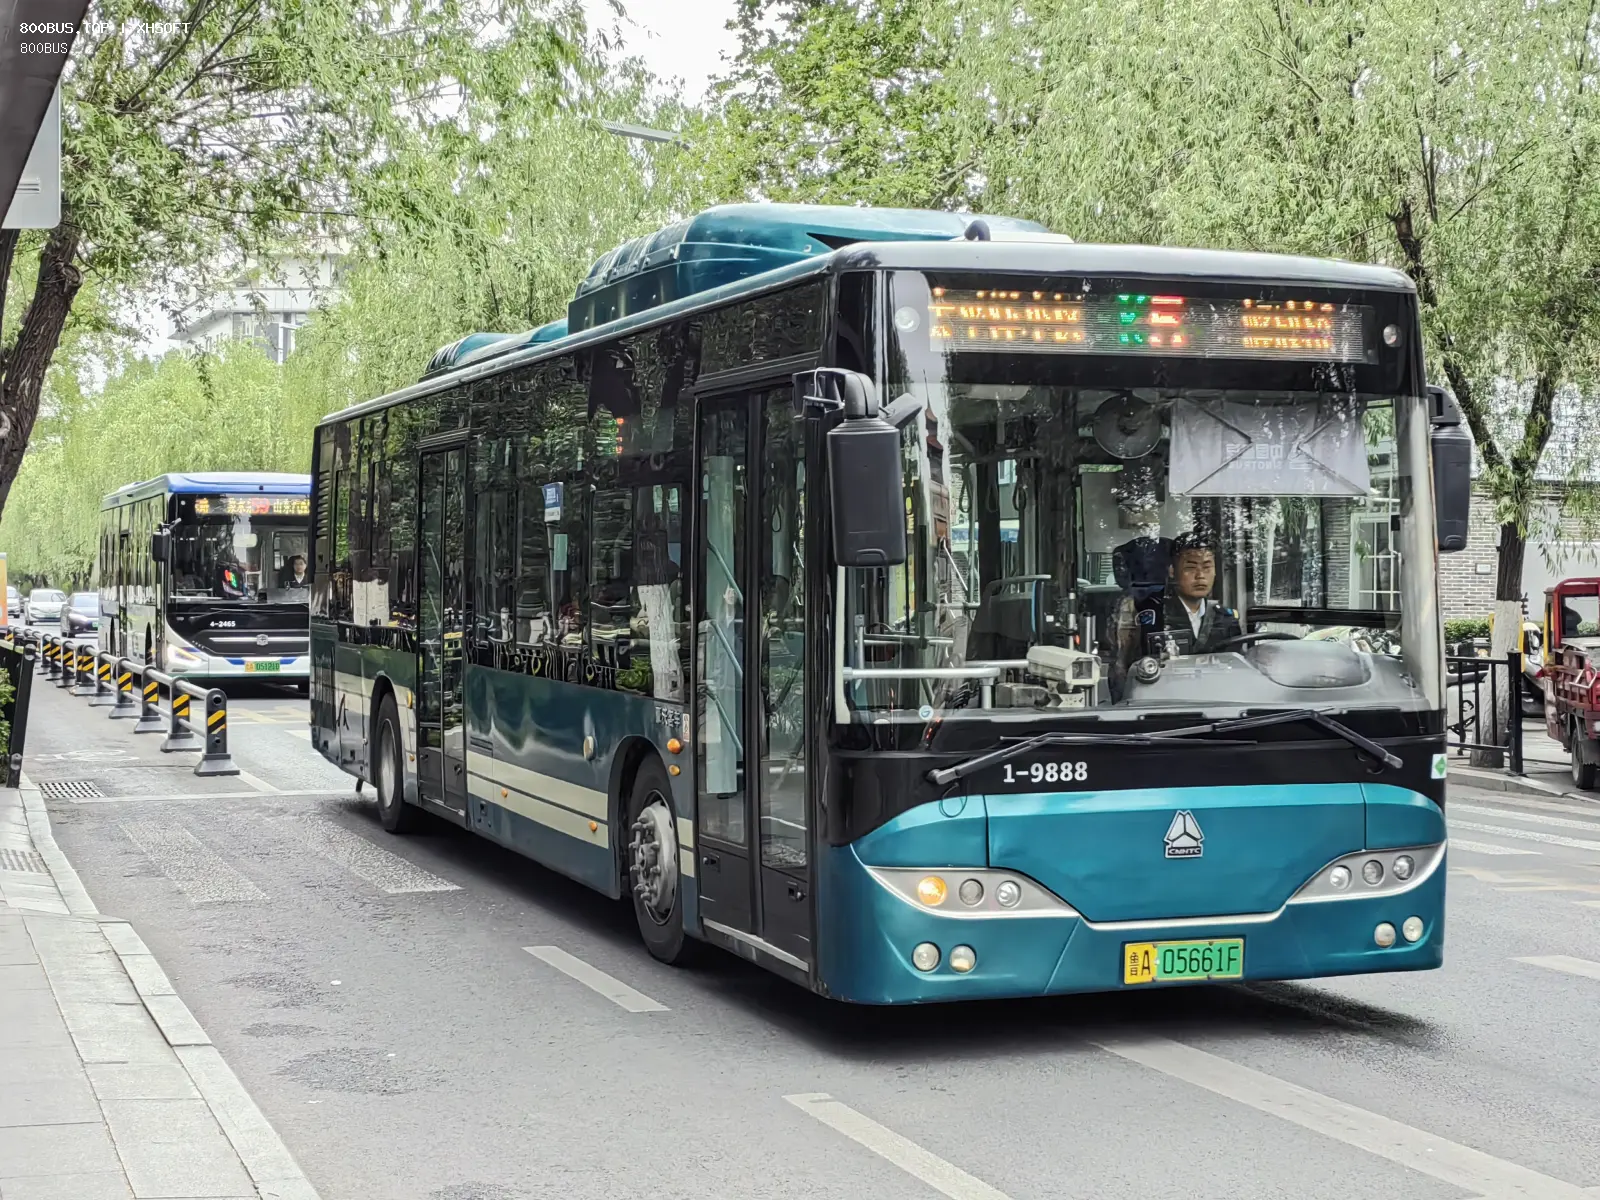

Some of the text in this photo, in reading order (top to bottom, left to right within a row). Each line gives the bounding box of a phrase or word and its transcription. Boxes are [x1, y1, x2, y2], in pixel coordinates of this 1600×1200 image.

[209, 620, 236, 628] 4-2465
[1003, 761, 1088, 783] 1-9888
[1168, 846, 1202, 856] CNHTC
